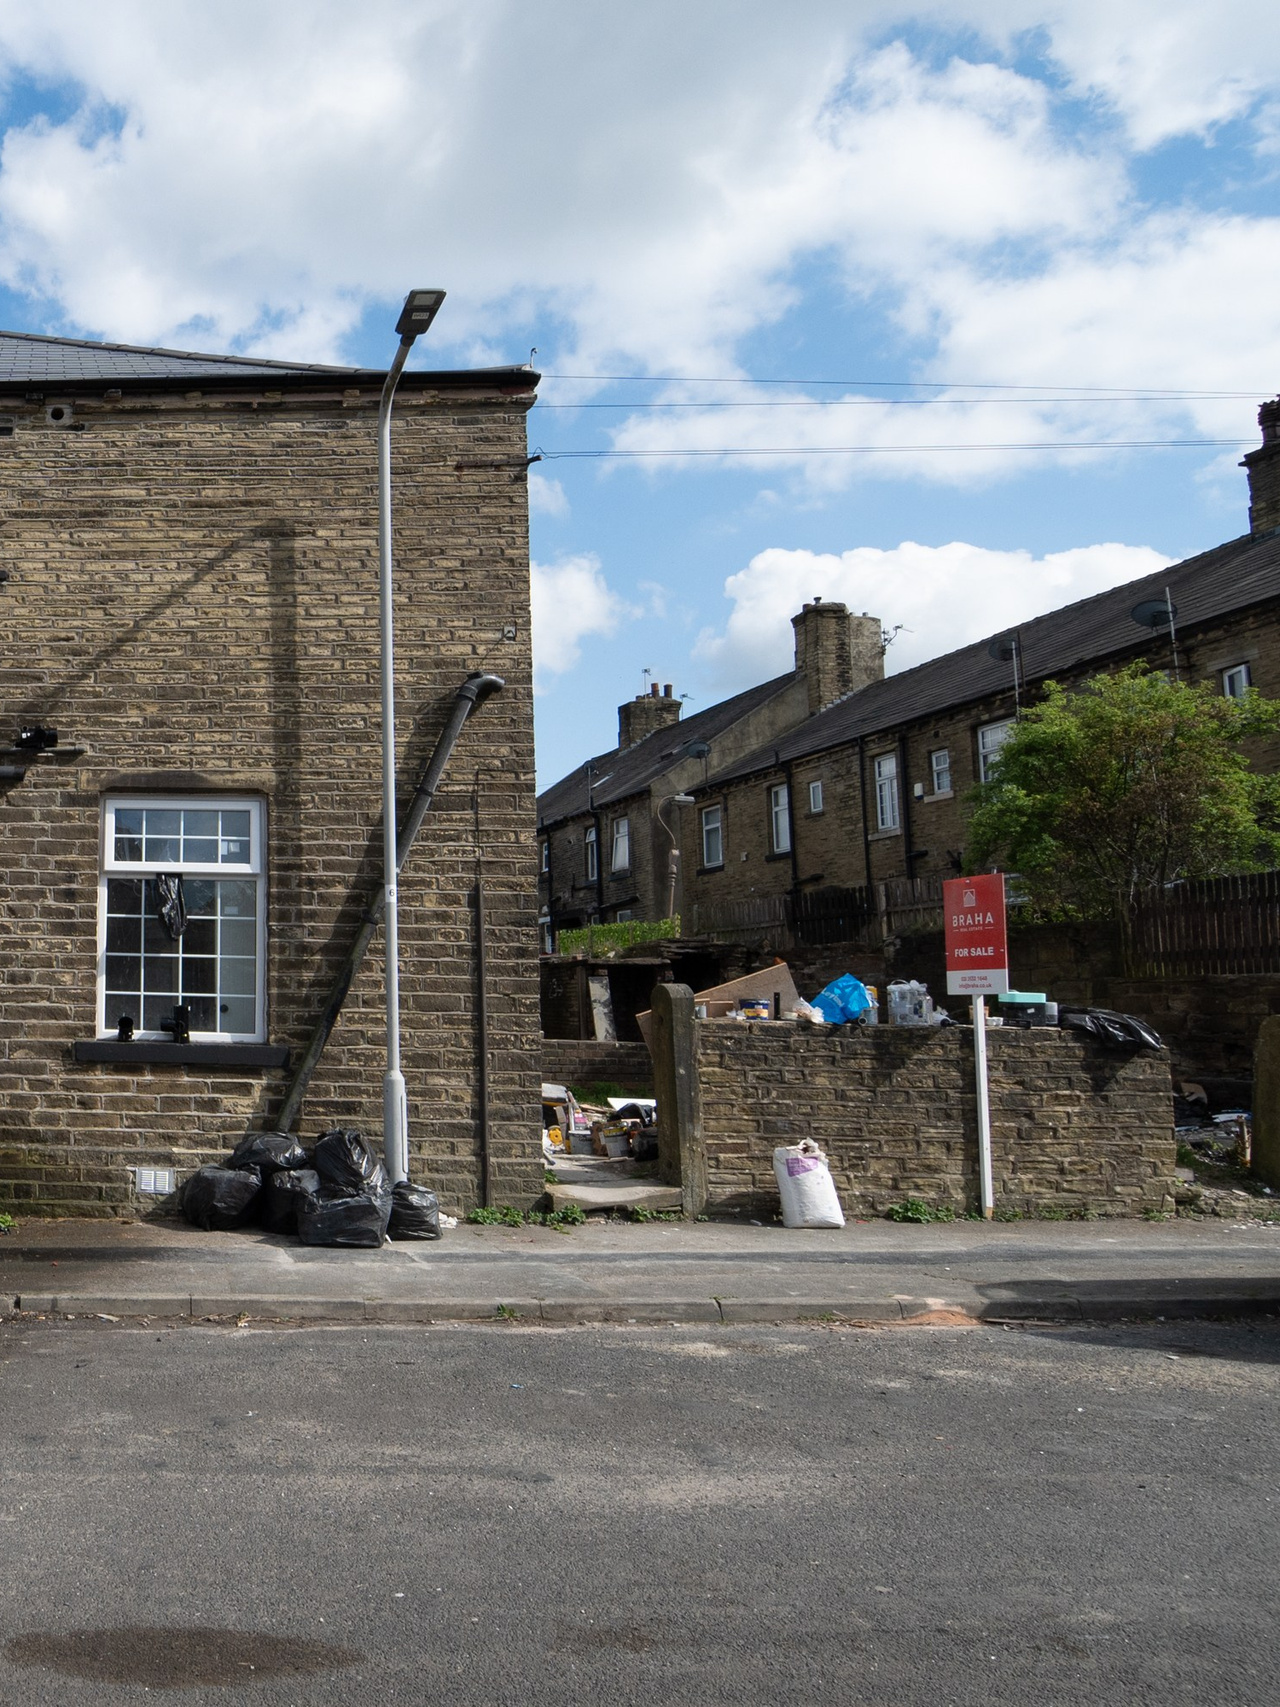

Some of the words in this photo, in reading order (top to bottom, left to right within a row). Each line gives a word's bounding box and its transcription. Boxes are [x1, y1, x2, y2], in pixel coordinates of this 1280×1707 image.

[389, 889, 395, 897] 6
[952, 912, 994, 927] BRAHA
[954, 948, 969, 957] FOR
[970, 947, 994, 956] SALE
